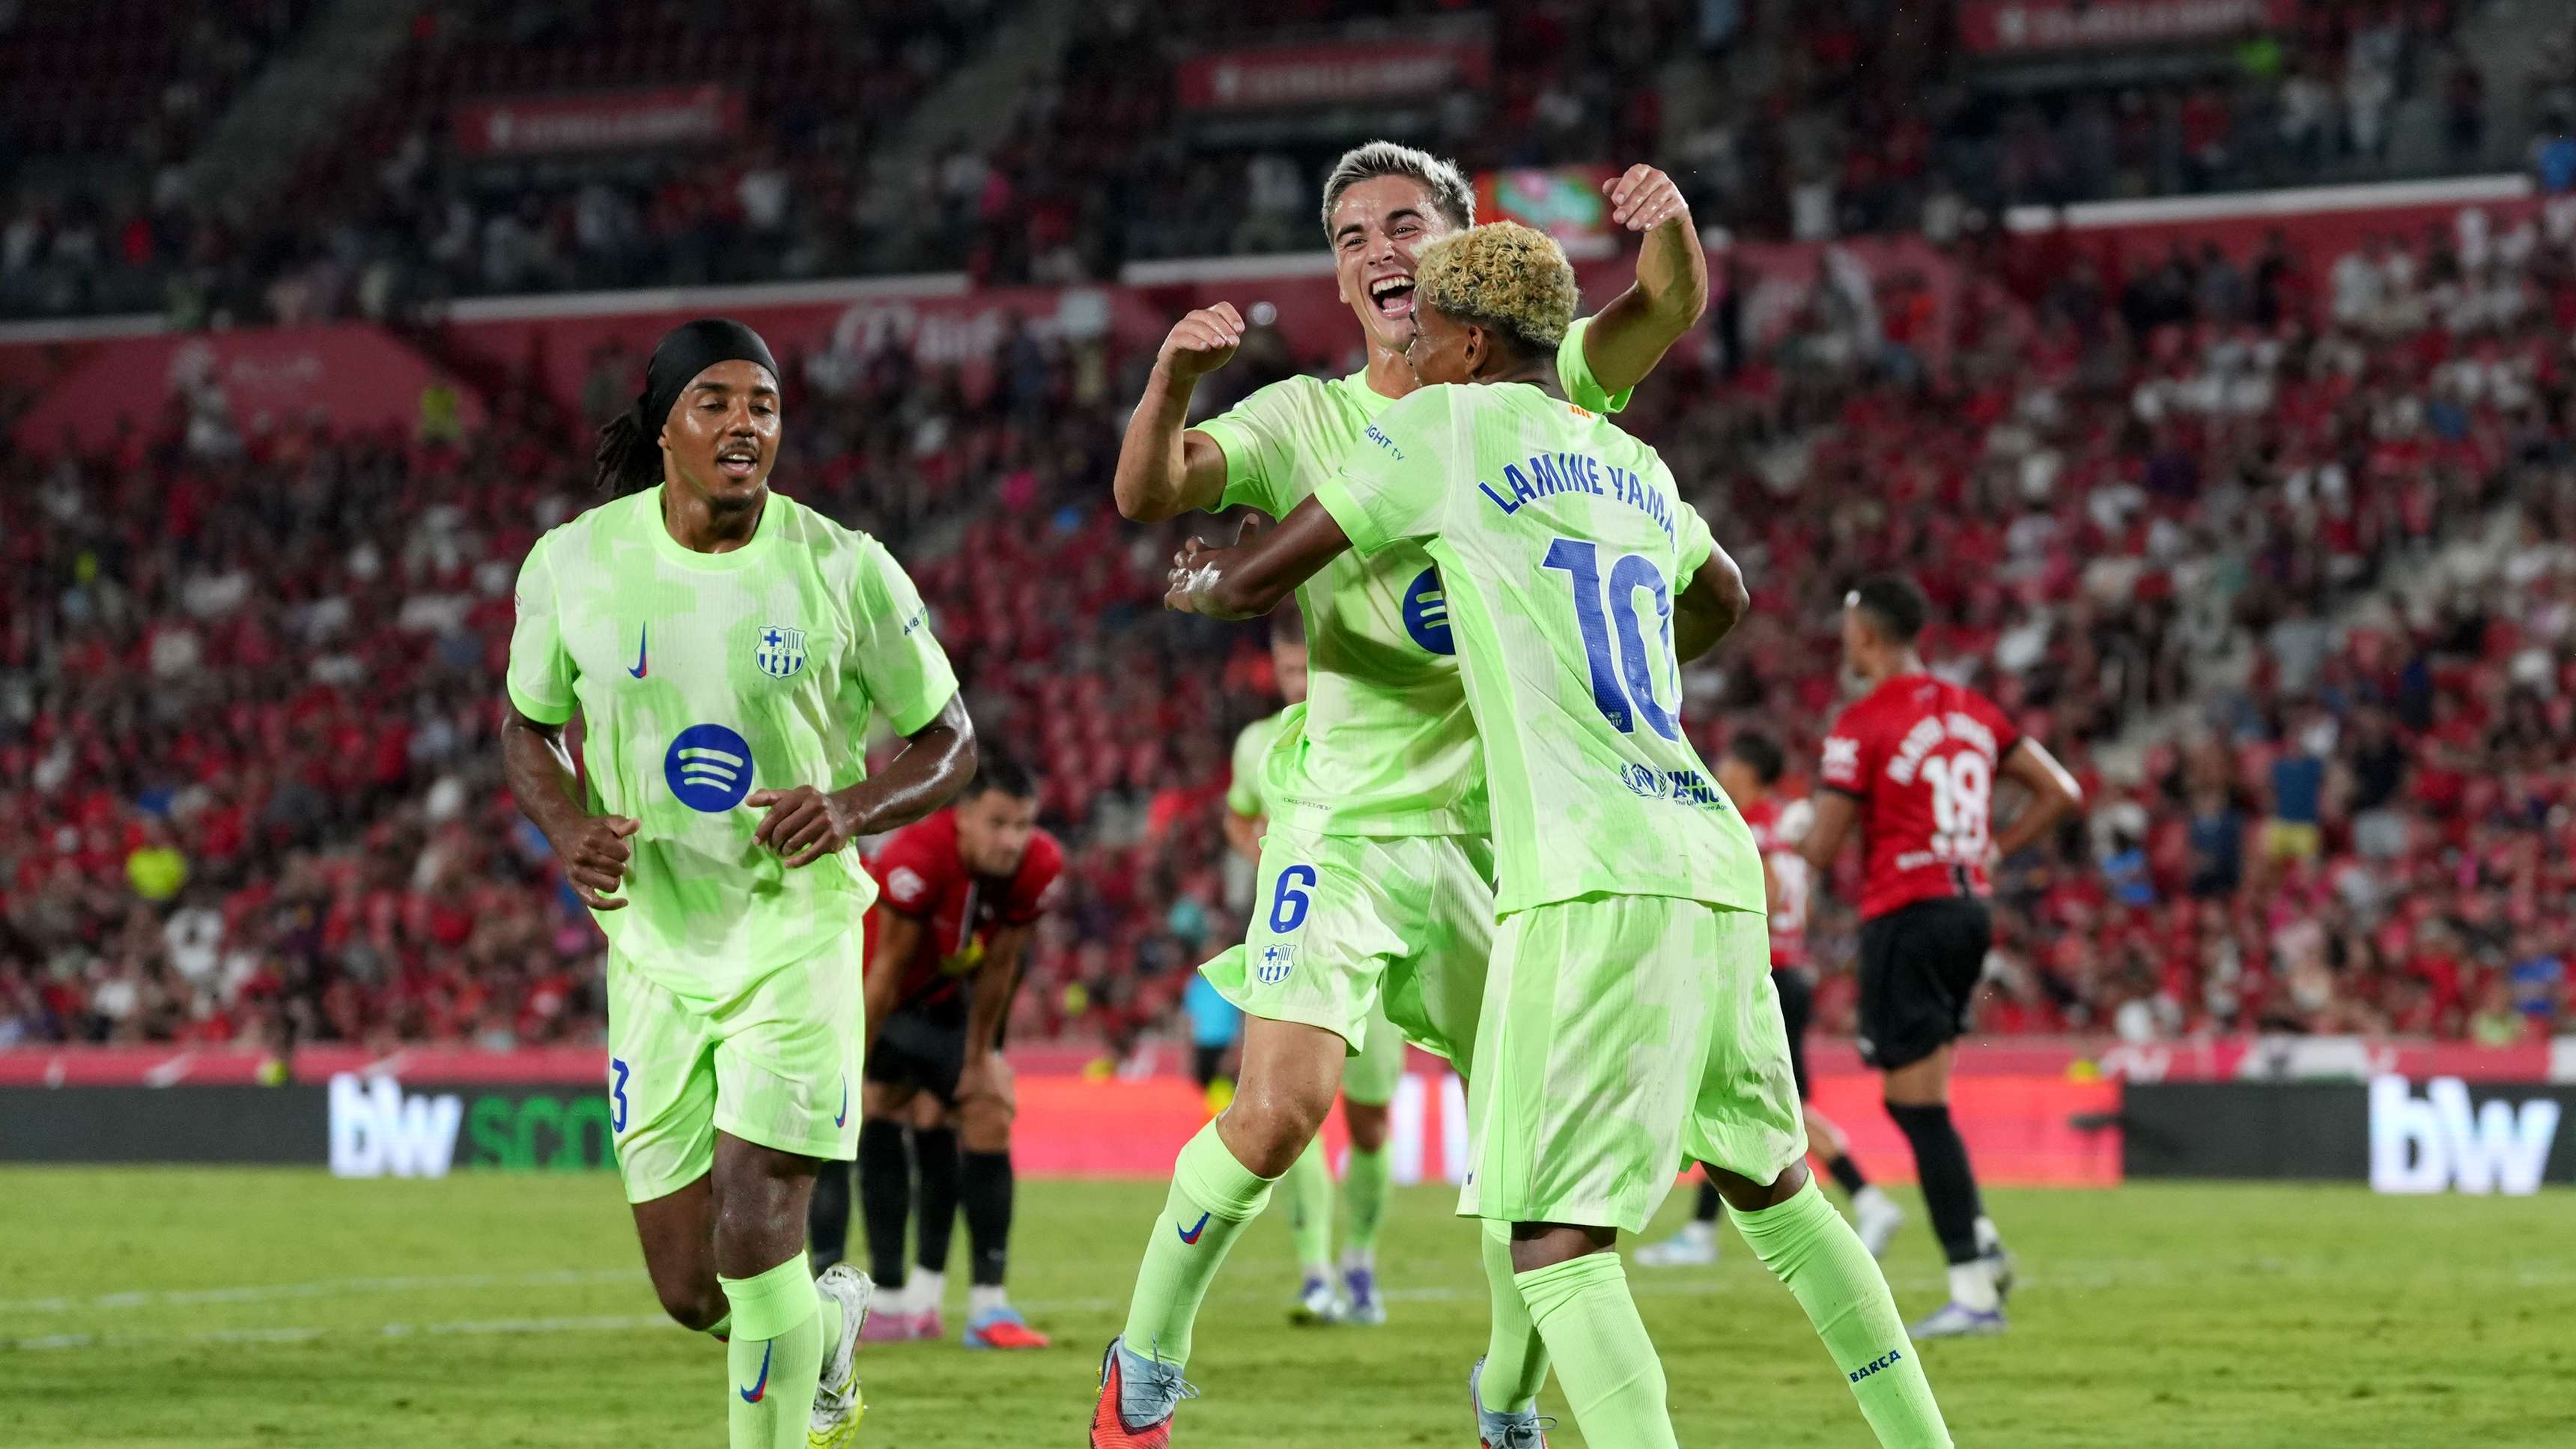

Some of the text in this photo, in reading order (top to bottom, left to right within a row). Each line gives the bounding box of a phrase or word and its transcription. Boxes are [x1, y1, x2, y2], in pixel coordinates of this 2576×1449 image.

[1364, 424, 1405, 461] IGHT tv
[1477, 452, 1605, 516] LAMINE
[1540, 537, 1683, 742] 10
[1269, 864, 1316, 934] 6
[1849, 1349, 1902, 1383] BARÇA
